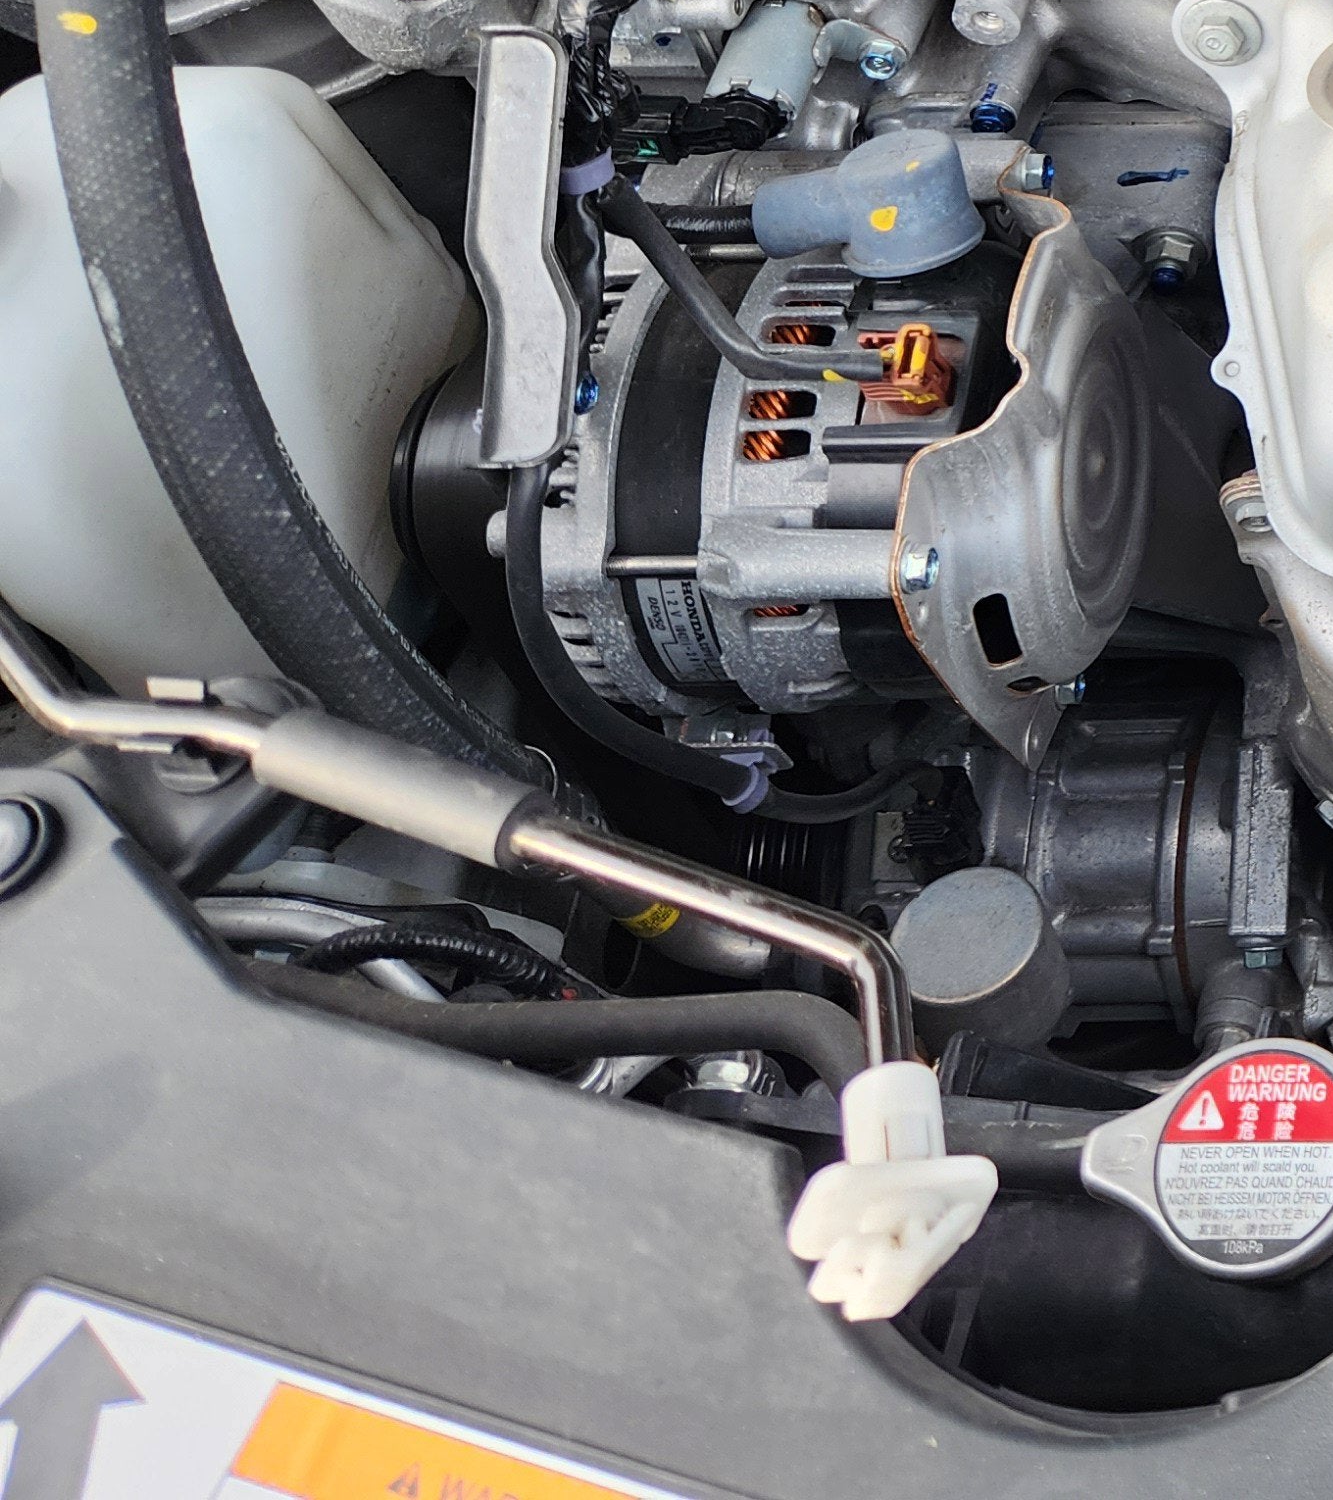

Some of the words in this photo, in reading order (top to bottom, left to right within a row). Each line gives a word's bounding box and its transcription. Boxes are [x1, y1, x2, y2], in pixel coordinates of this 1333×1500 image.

[647, 596, 667, 631] DENSO
[681, 581, 706, 642] HONDA
[1229, 1063, 1312, 1083] DANGER
[1227, 1083, 1328, 1102] WARNUNG
[1181, 1146, 1222, 1160] NEVER
[1225, 1146, 1259, 1159] OPEN
[1263, 1146, 1300, 1159] WHEN
[1303, 1146, 1333, 1159] HOT.
[1179, 1162, 1198, 1174] Hot
[1200, 1162, 1240, 1174] coolant
[1242, 1162, 1260, 1173] will
[1262, 1162, 1292, 1173] scald
[1165, 1177, 1222, 1190] N'OUVREZ
[1225, 1176, 1250, 1189] PAS
[1252, 1176, 1293, 1189] QUAND
[1257, 1192, 1291, 1204] MOTOR
